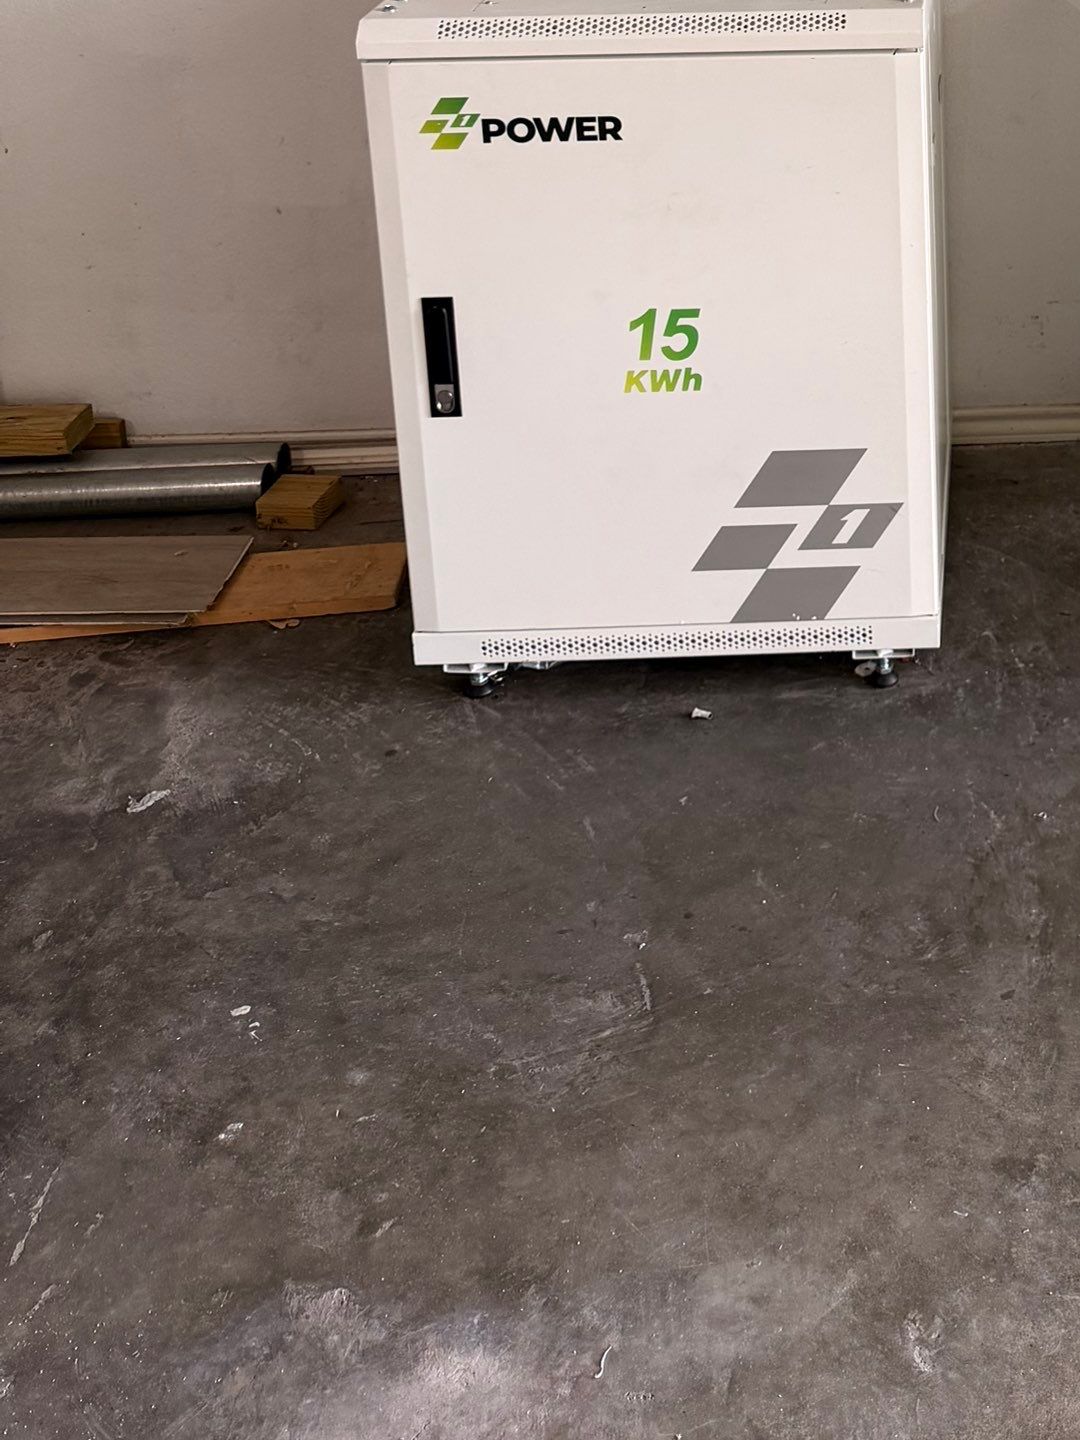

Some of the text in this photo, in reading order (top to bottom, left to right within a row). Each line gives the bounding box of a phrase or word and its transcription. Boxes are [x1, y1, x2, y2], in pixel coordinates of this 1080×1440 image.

[460, 114, 624, 143] 1 POWER
[629, 308, 701, 361] 15
[624, 367, 702, 393] KWh
[832, 508, 870, 544] 1
